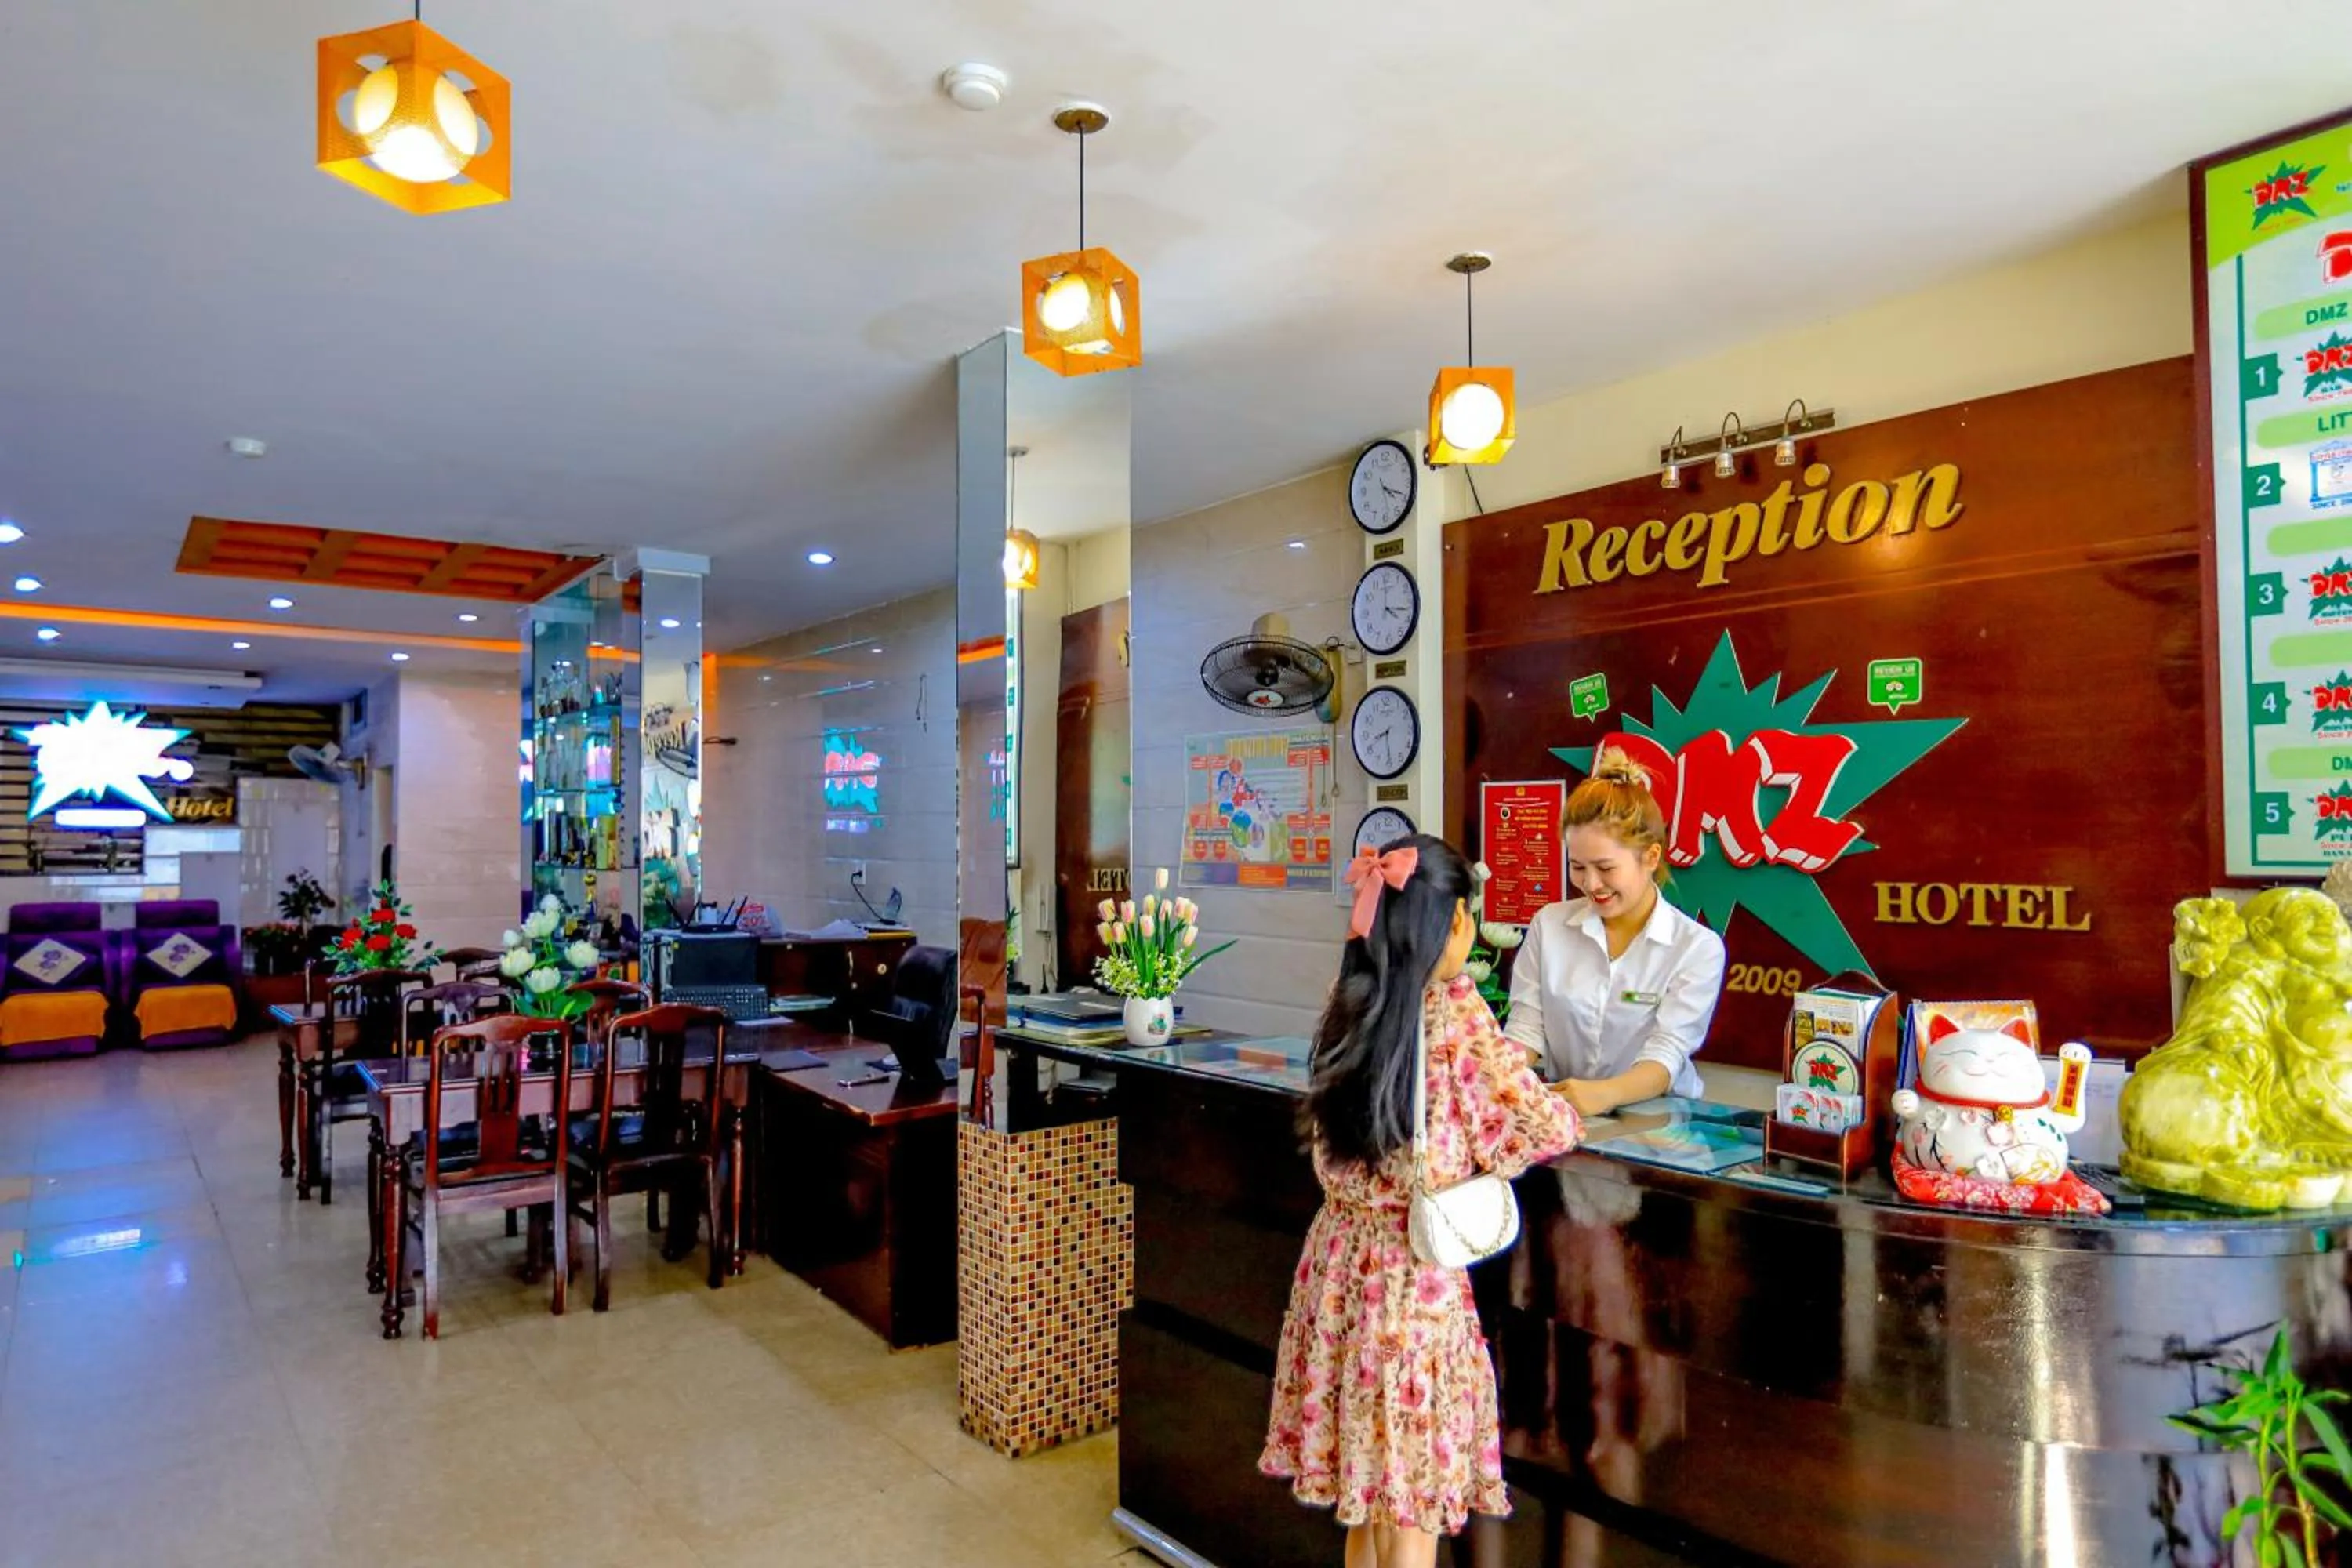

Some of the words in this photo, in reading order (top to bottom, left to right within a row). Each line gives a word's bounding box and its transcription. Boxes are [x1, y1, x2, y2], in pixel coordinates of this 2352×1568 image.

[2253, 170, 2309, 208] DMZ
[2306, 302, 2347, 325] DMZ
[2256, 367, 2265, 387] 1
[2256, 475, 2271, 495] 2
[1533, 463, 1963, 594] Reception
[2259, 584, 2274, 604] 3
[2262, 692, 2277, 713] 4
[167, 797, 234, 817] Hotel
[2266, 803, 2279, 822] 5
[1873, 882, 2092, 931] HOTEL
[1727, 964, 1802, 996] 2009
